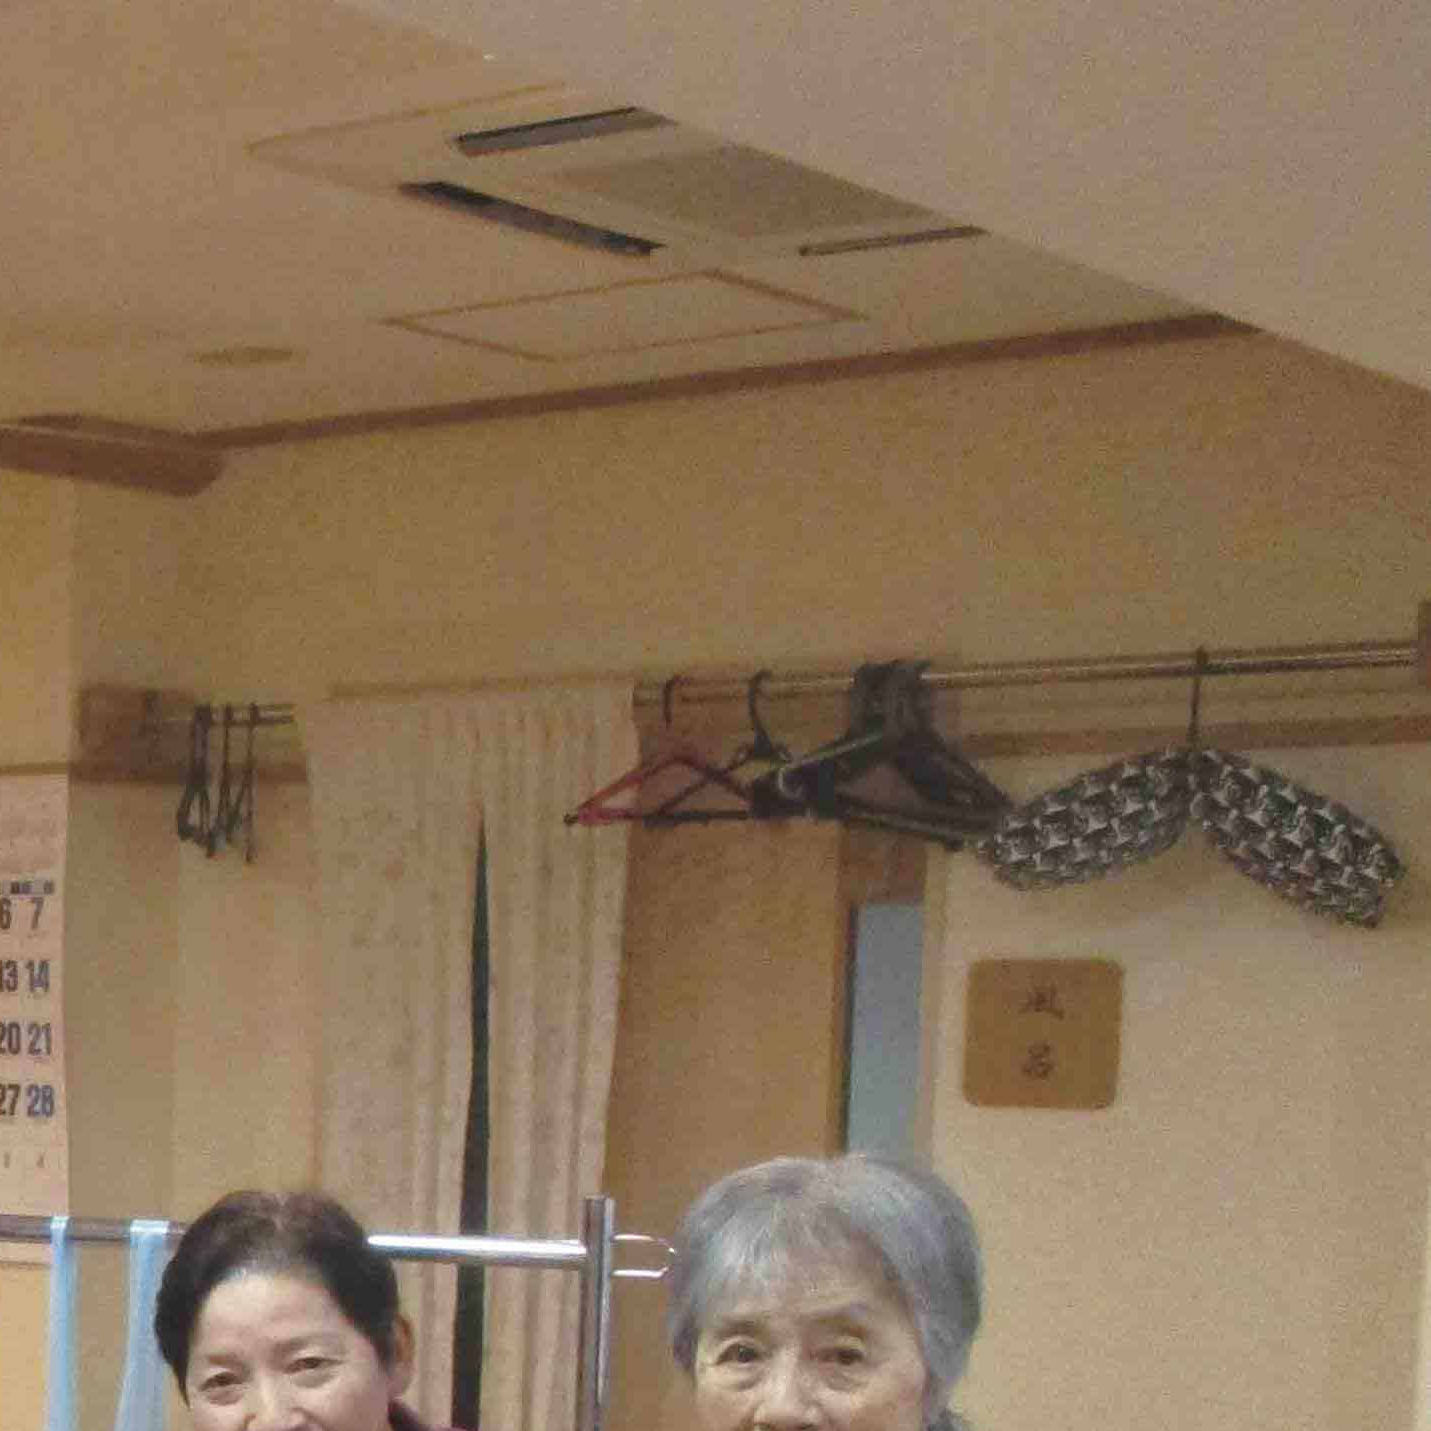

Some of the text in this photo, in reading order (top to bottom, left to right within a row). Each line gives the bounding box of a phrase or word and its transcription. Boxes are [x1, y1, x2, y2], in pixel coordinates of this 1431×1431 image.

[30, 898, 44, 929] 7
[25, 960, 50, 992] 14
[28, 1022, 52, 1055] 21
[27, 1084, 54, 1117] 28
